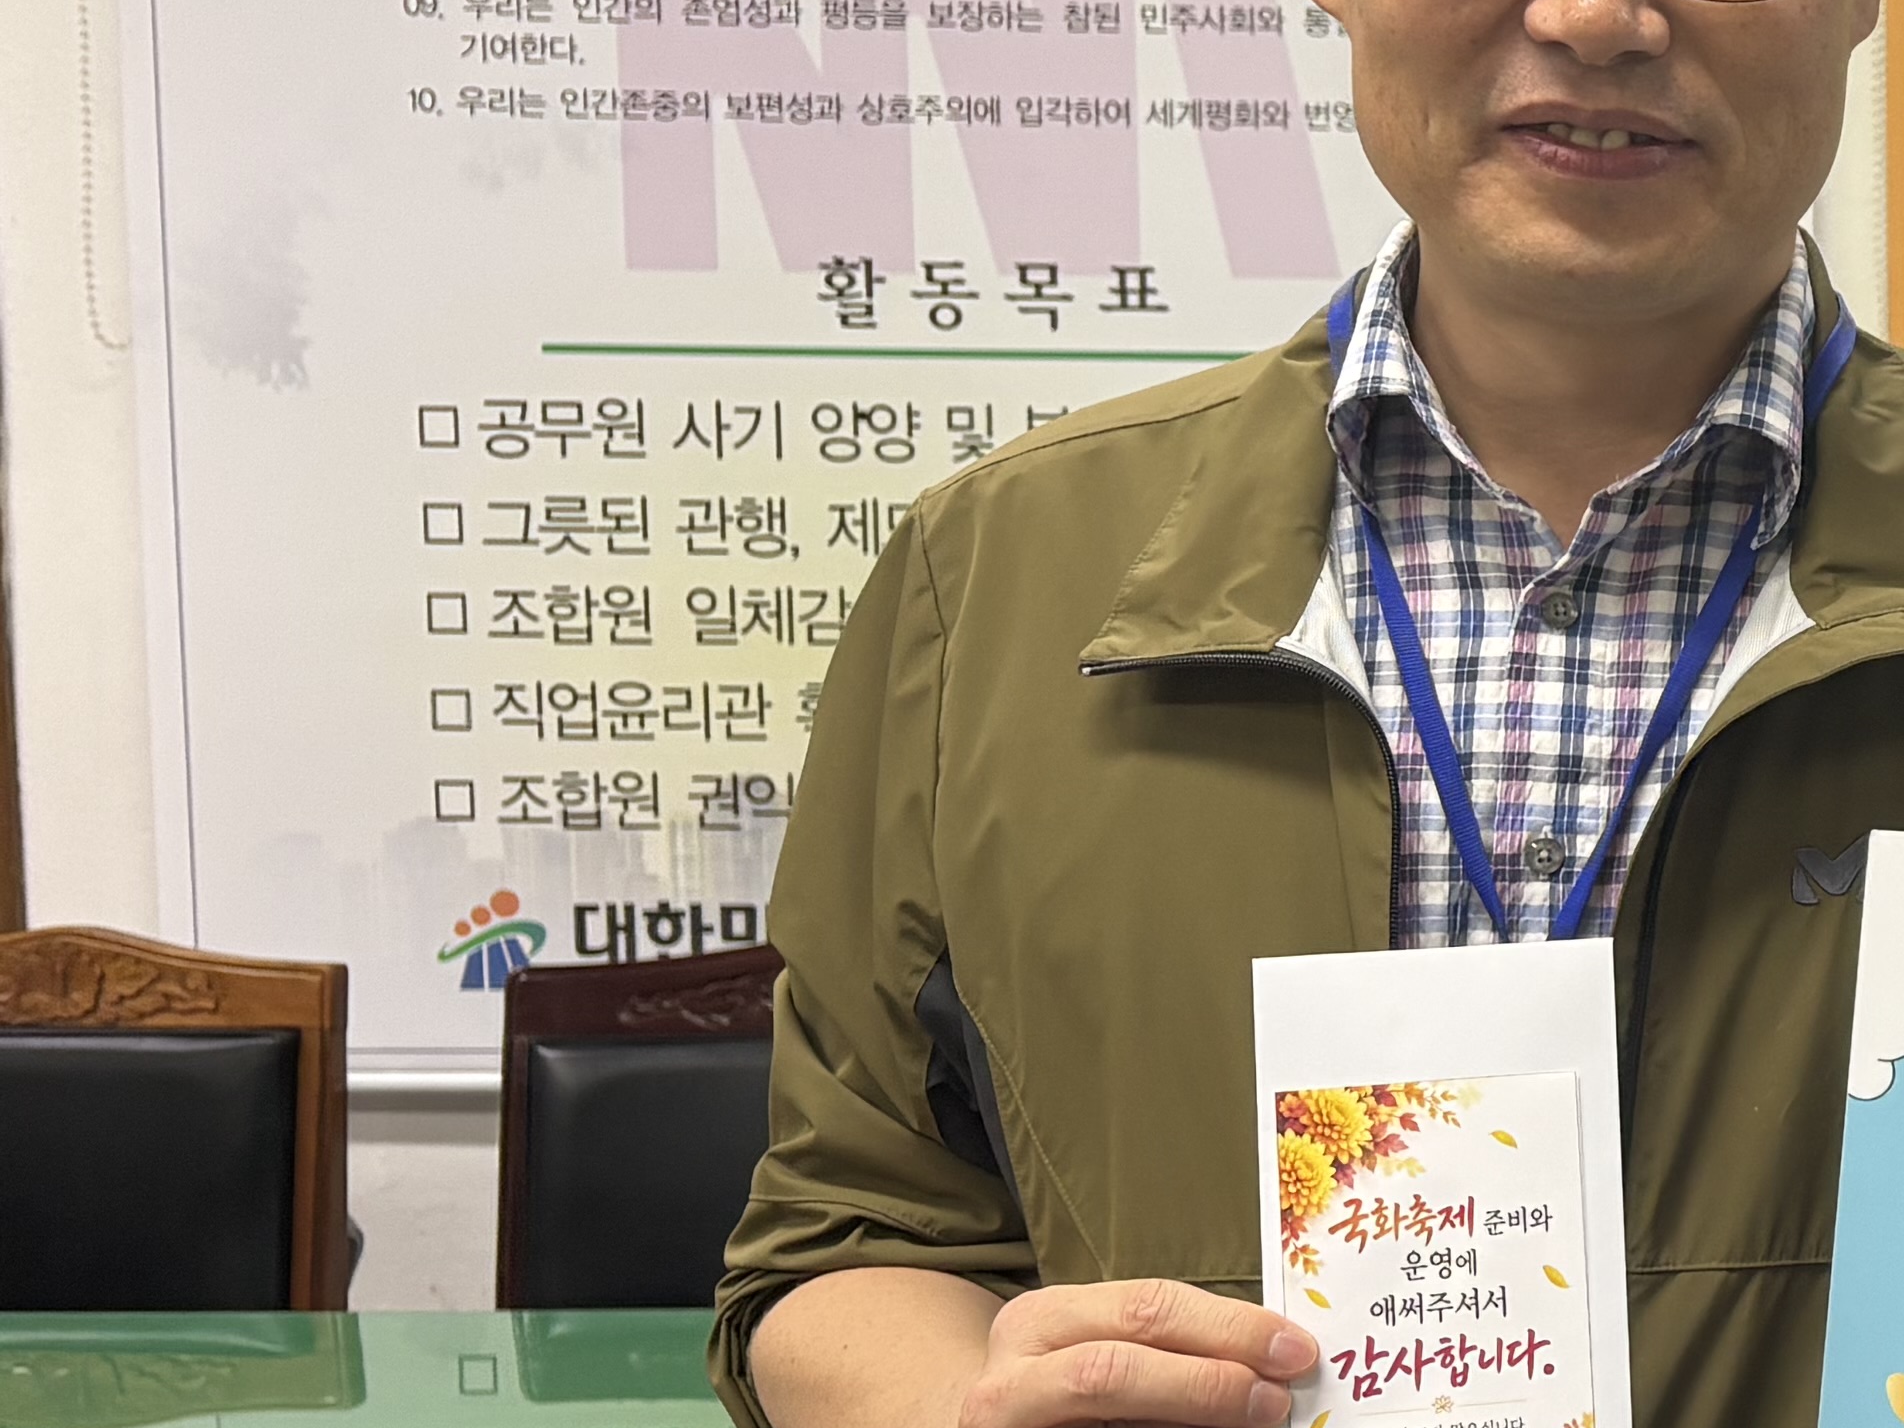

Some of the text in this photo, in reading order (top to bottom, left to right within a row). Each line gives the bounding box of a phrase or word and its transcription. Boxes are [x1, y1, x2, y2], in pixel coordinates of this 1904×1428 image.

[926, 1, 1044, 32] 보장하는
[1140, 5, 1284, 34] 민주사회와
[460, 34, 585, 64] 기여한다.
[407, 87, 1132, 127] 10. 우리는 인간존중의 보편성과 입각하여
[477, 397, 649, 461] 공무원
[671, 398, 784, 461] 사기
[945, 401, 996, 464] 및
[481, 493, 652, 557] 그릇된
[675, 494, 801, 561] 관행,
[487, 584, 654, 647] 조합원
[491, 680, 773, 742] 직업윤리관
[497, 770, 662, 831] 조합원
[1327, 1193, 1554, 1254] 국화축제 준비와
[1399, 1247, 1479, 1282] 운영에
[1369, 1284, 1509, 1328] 애써주셔서
[1329, 1328, 1556, 1403] 감사합니다.
